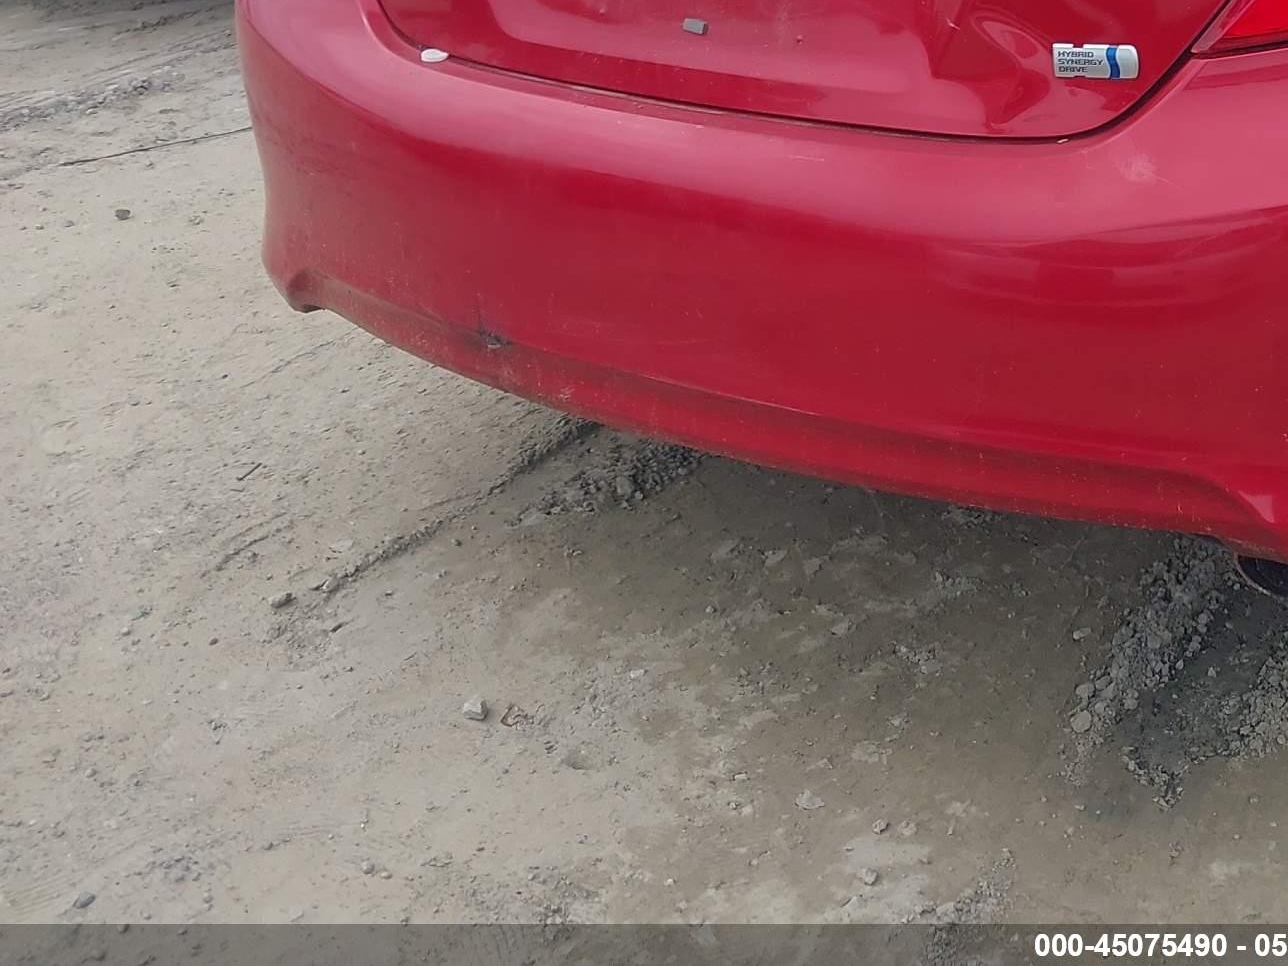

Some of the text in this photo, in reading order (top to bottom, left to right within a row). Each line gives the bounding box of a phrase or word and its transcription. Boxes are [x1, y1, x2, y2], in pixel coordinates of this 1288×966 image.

[1057, 50, 1094, 58] HYBRID
[1057, 58, 1104, 66] SYNERGY
[1058, 65, 1089, 73] DRIVE
